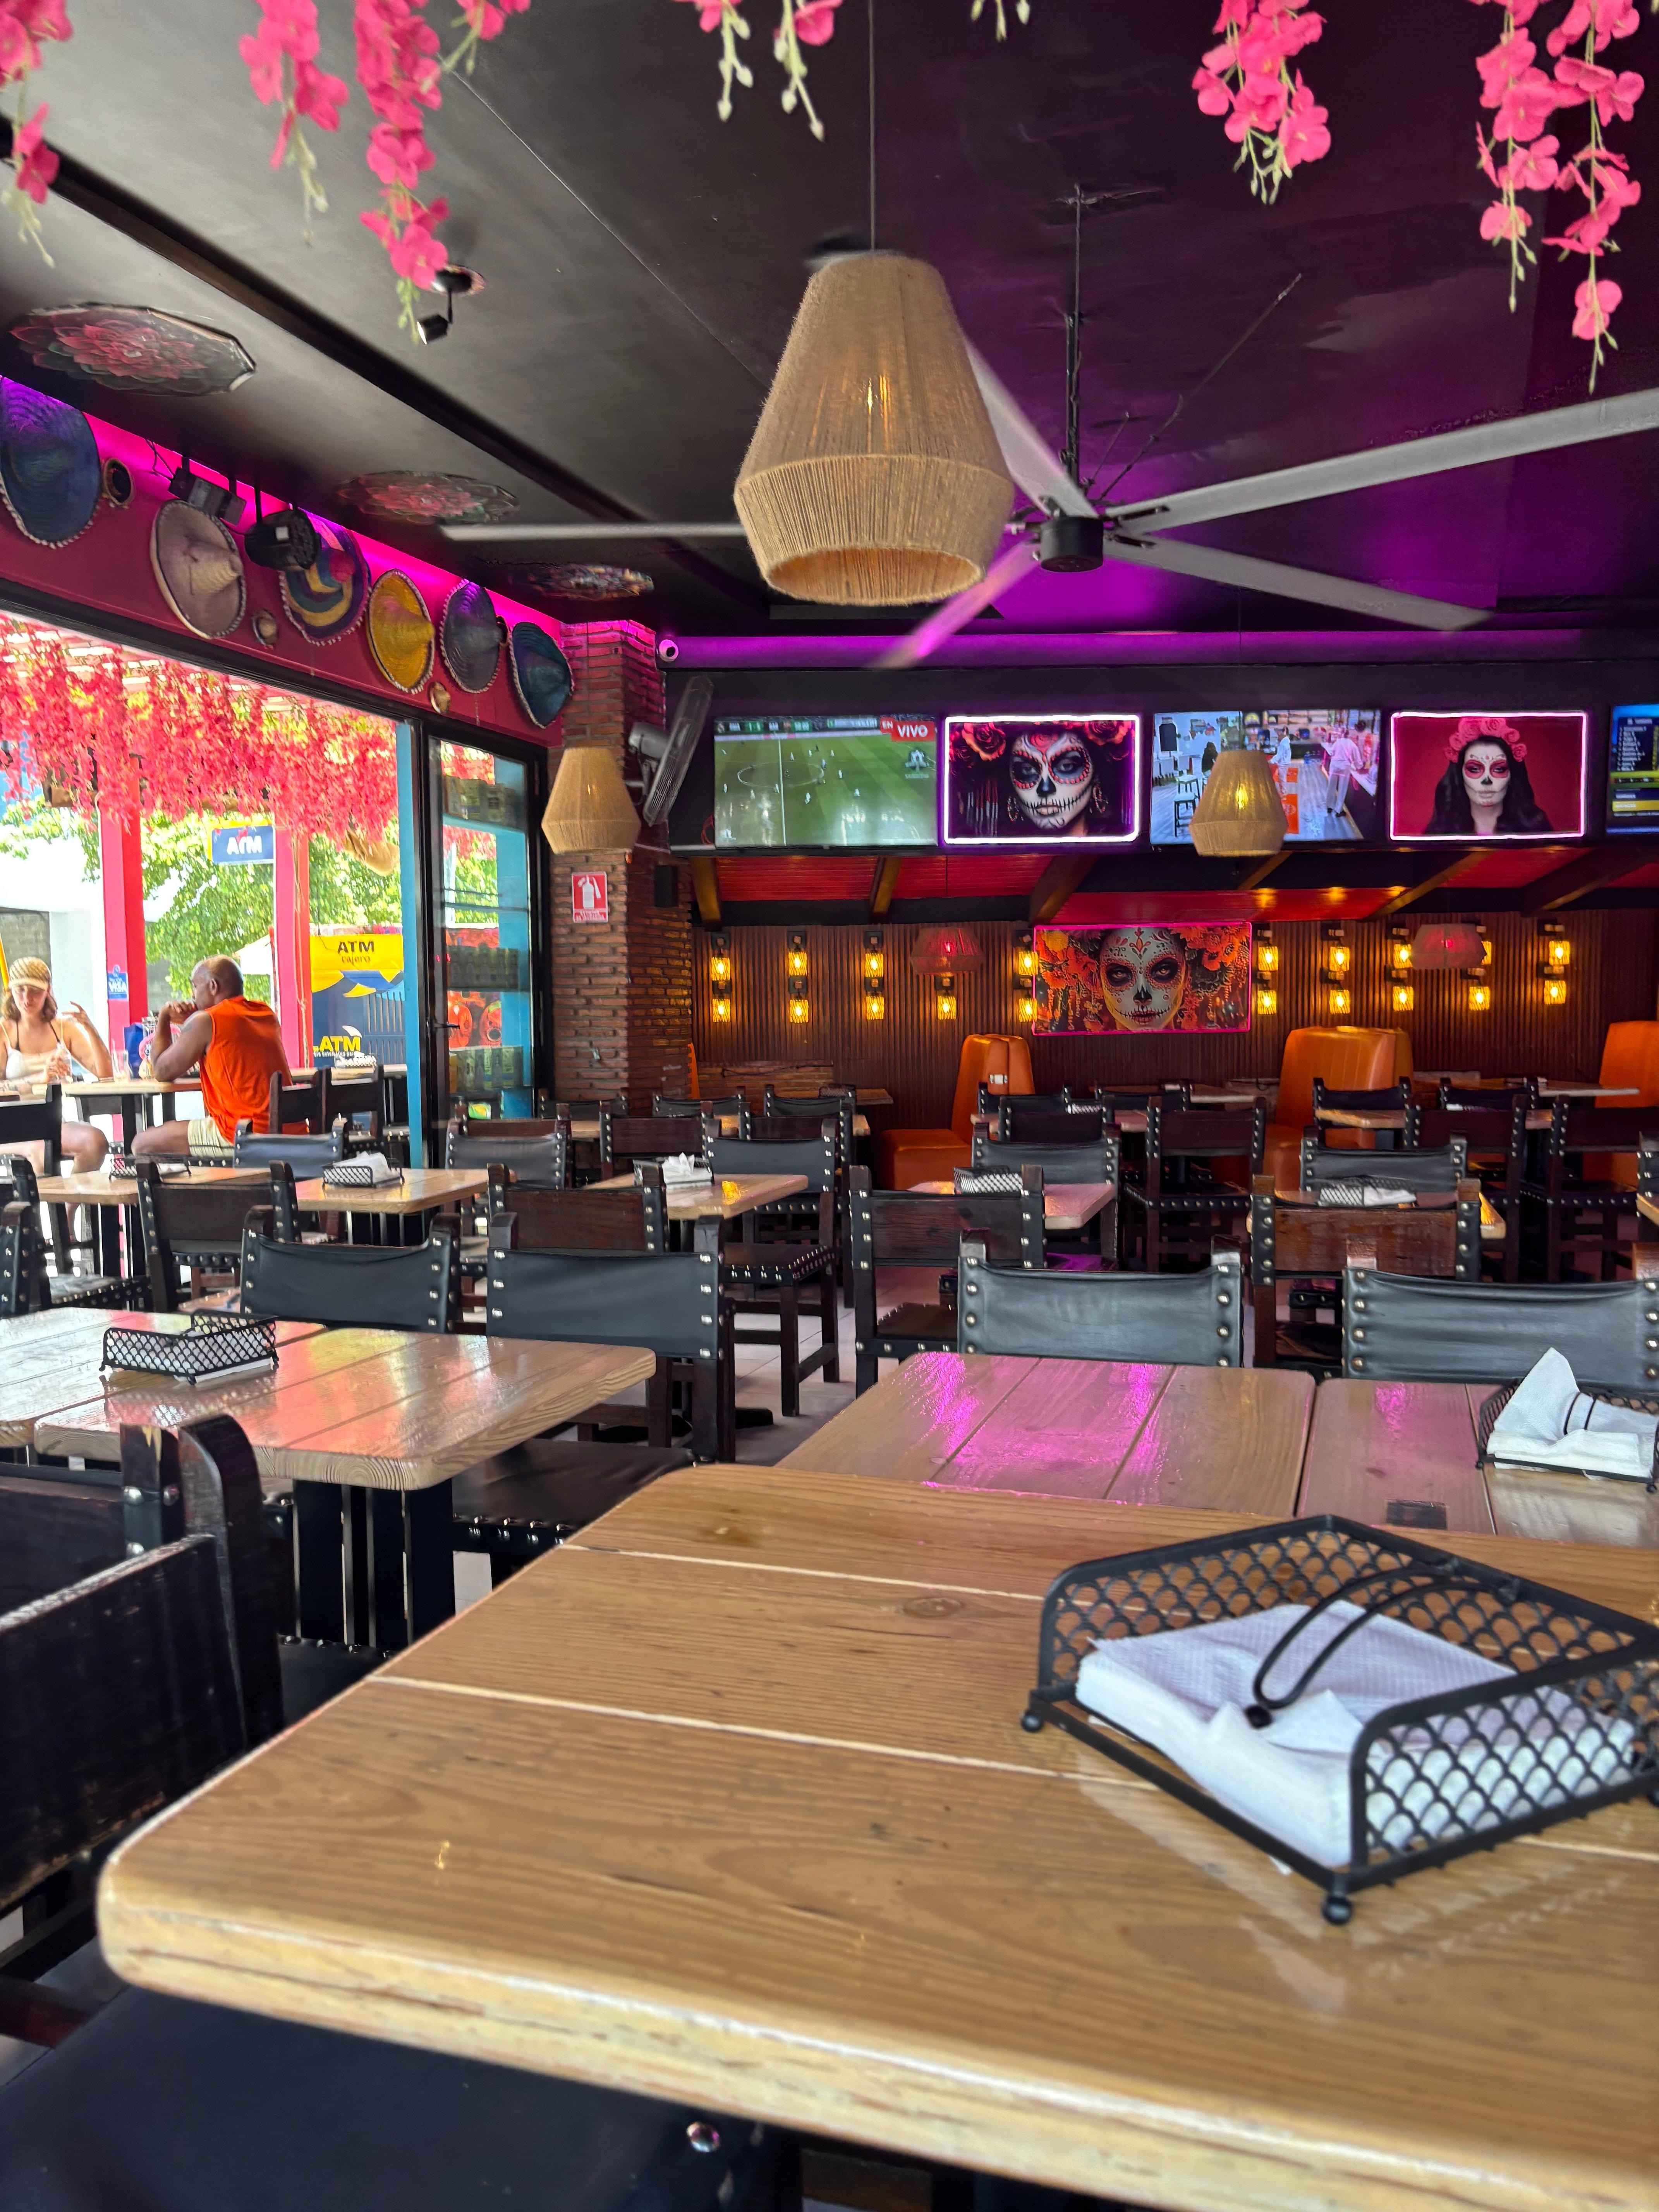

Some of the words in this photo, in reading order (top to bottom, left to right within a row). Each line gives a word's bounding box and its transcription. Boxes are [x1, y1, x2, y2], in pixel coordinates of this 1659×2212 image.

[882, 720, 893, 729] EN
[897, 725, 928, 738] VIVO
[337, 941, 375, 954] ATM
